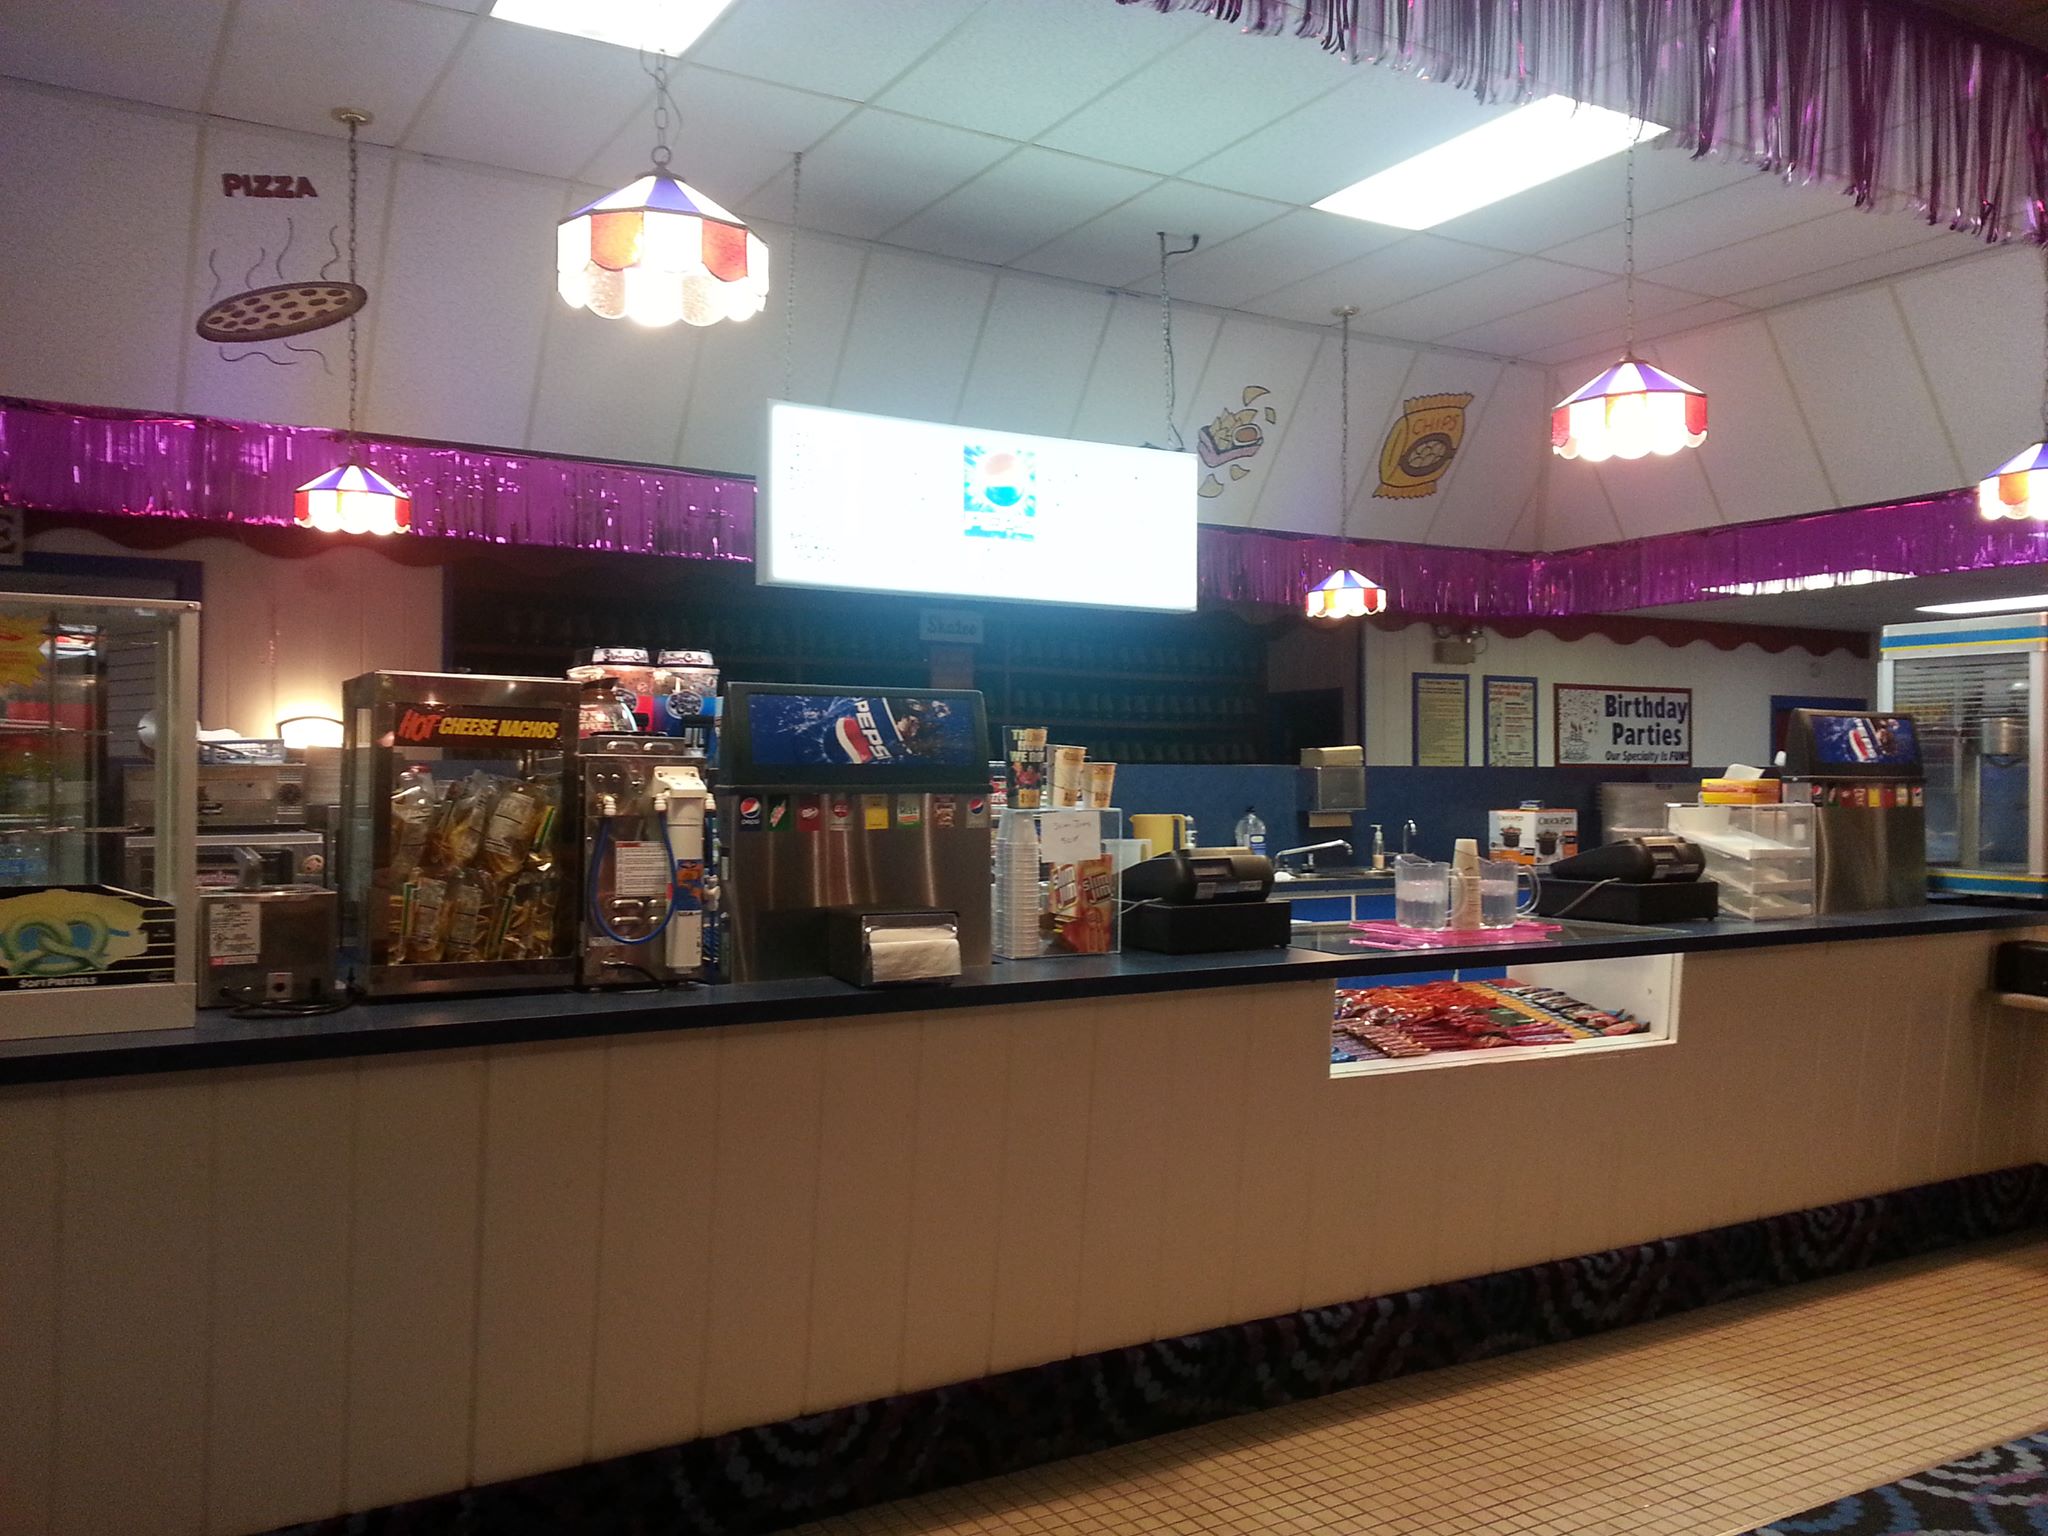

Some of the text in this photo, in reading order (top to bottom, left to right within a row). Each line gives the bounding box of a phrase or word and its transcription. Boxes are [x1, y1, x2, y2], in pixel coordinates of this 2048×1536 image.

[221, 173, 318, 199] PIZZA
[1412, 413, 1461, 435] CHIPS
[1605, 693, 1688, 724] Birthday
[398, 708, 442, 742] HOT
[438, 717, 499, 736] CHEESE
[497, 719, 560, 739] NACHOS
[854, 700, 893, 760] PEPSI
[1612, 722, 1682, 746] Parties
[1605, 750, 1620, 761] Our
[1623, 750, 1659, 763] Specialty
